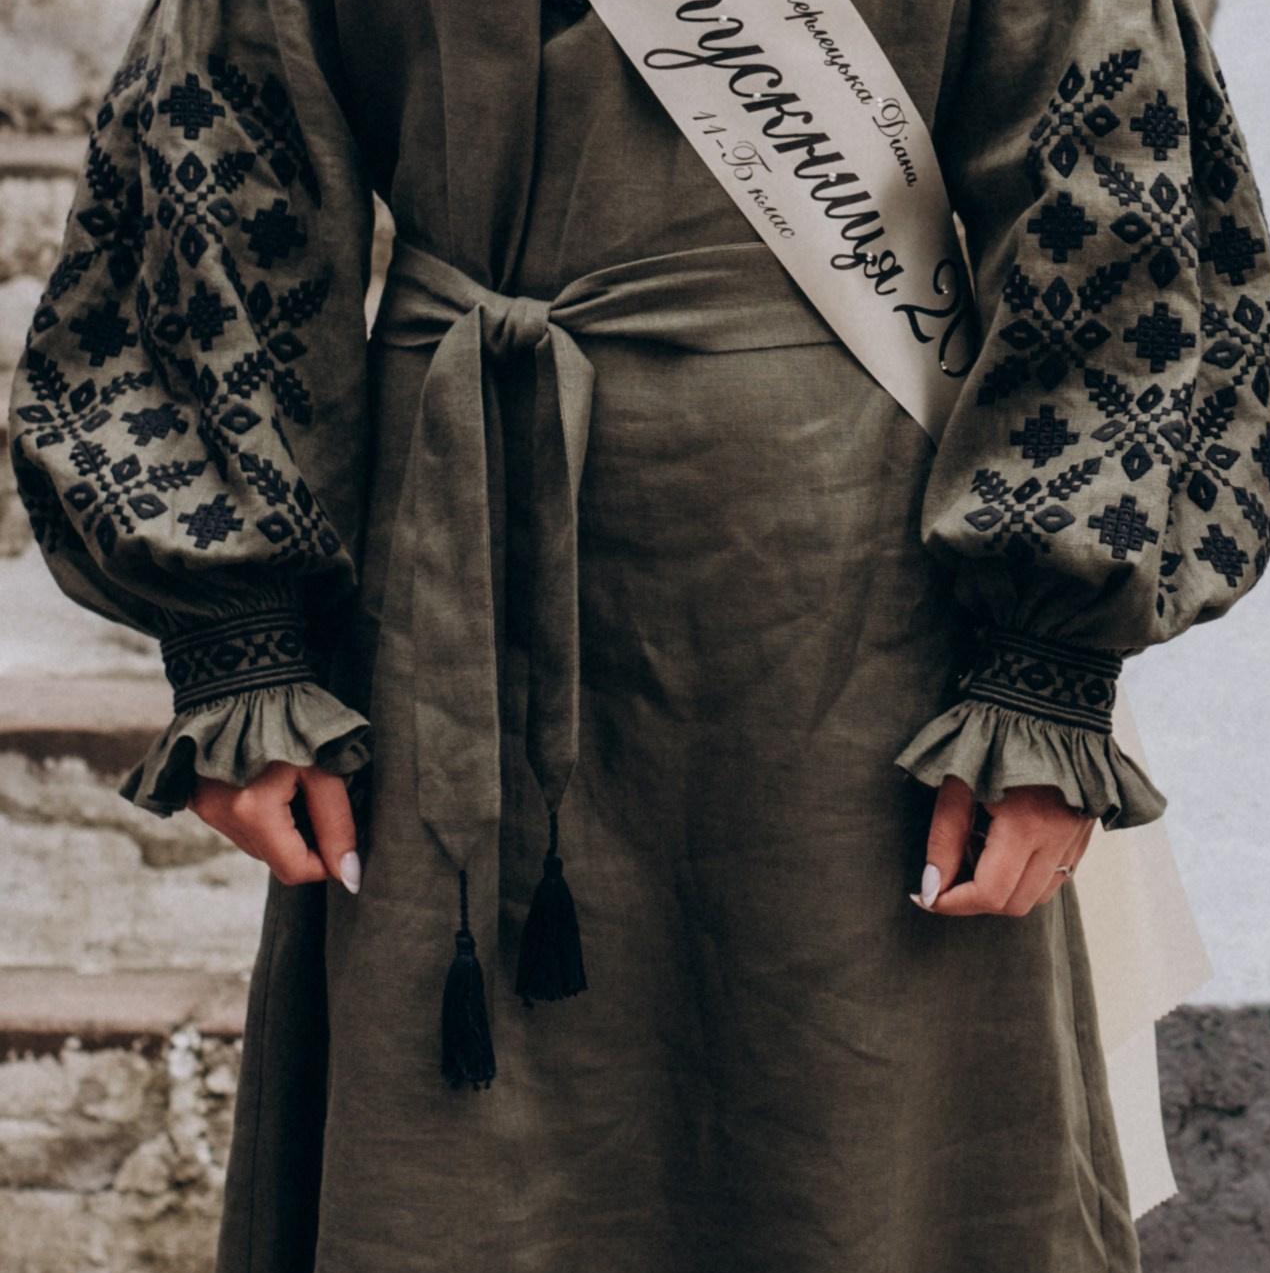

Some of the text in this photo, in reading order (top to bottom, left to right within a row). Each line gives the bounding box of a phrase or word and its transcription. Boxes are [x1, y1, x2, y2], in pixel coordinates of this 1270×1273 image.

[692, 111, 795, 239] 11-Б клас
[872, 97, 919, 188] Діана
